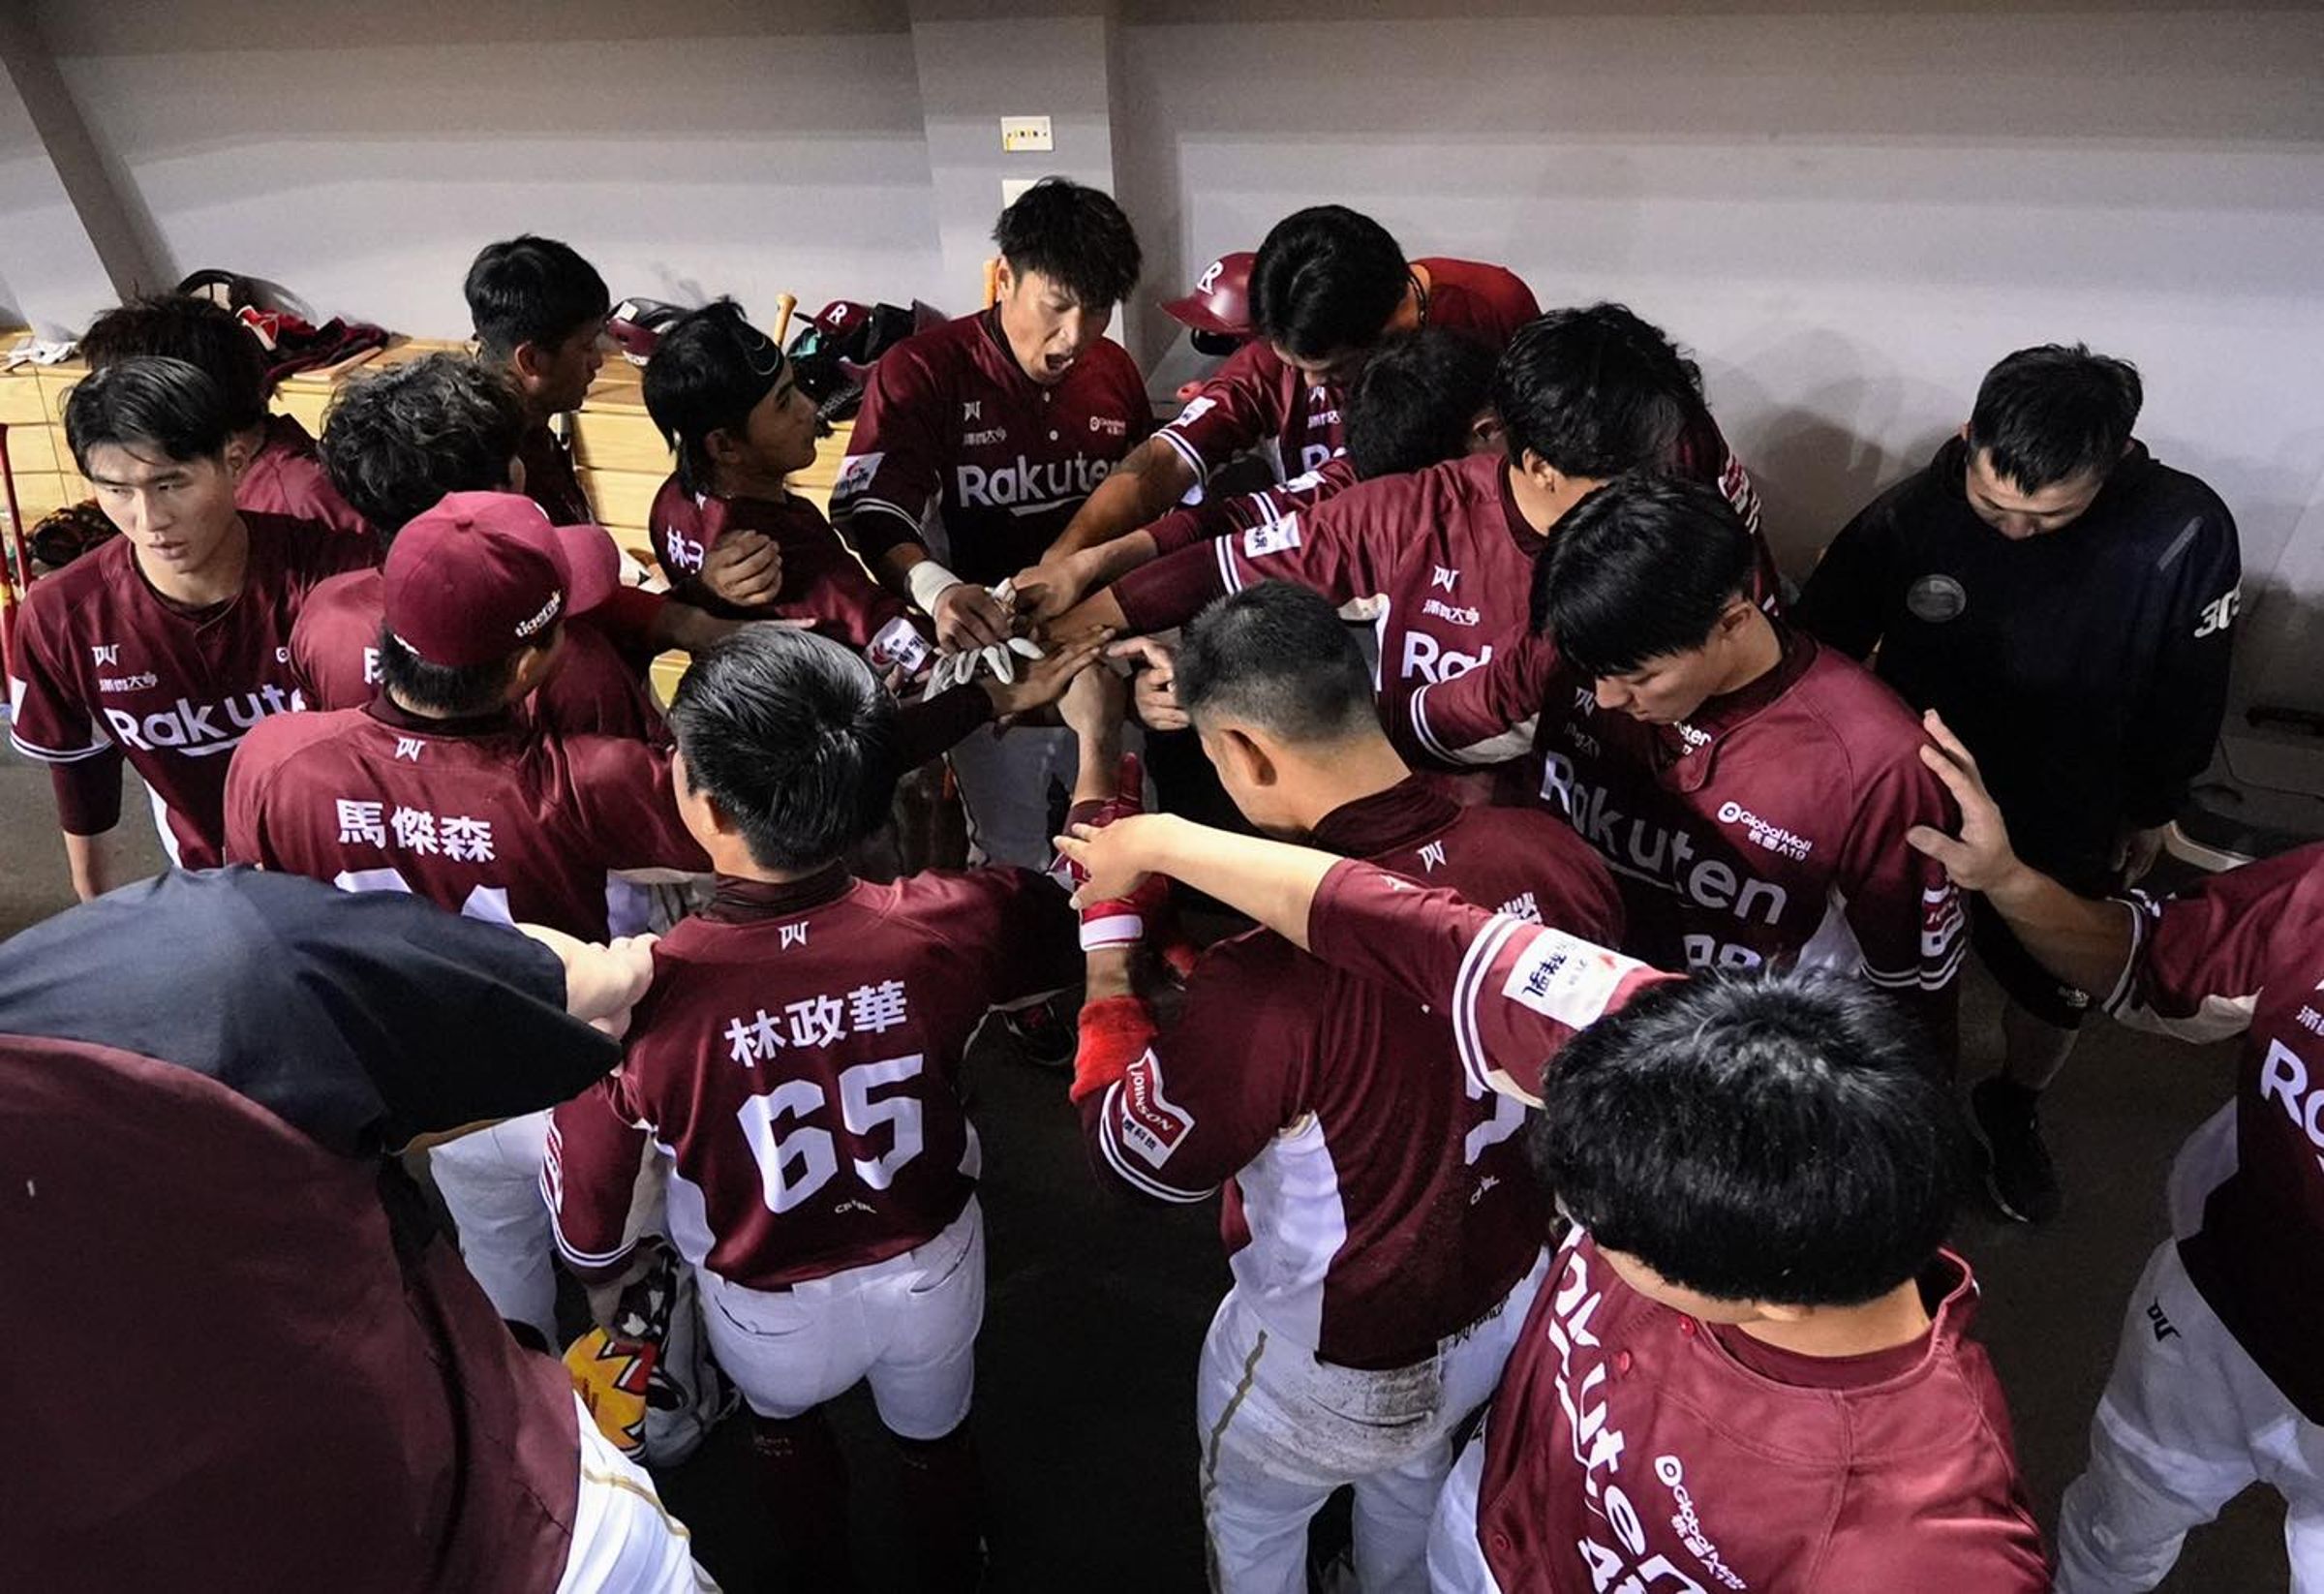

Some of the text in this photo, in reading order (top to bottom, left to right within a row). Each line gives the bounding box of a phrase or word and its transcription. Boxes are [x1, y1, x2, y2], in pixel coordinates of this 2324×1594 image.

[1197, 261, 1223, 295] R
[826, 303, 847, 325] R
[957, 450, 1127, 507] Rakute
[335, 799, 496, 863] 馬傑森
[1539, 750, 1788, 925] Rakuten
[723, 979, 908, 1068] 林政華
[1130, 1070, 1174, 1131] JOHNSON
[736, 1053, 924, 1214] 65
